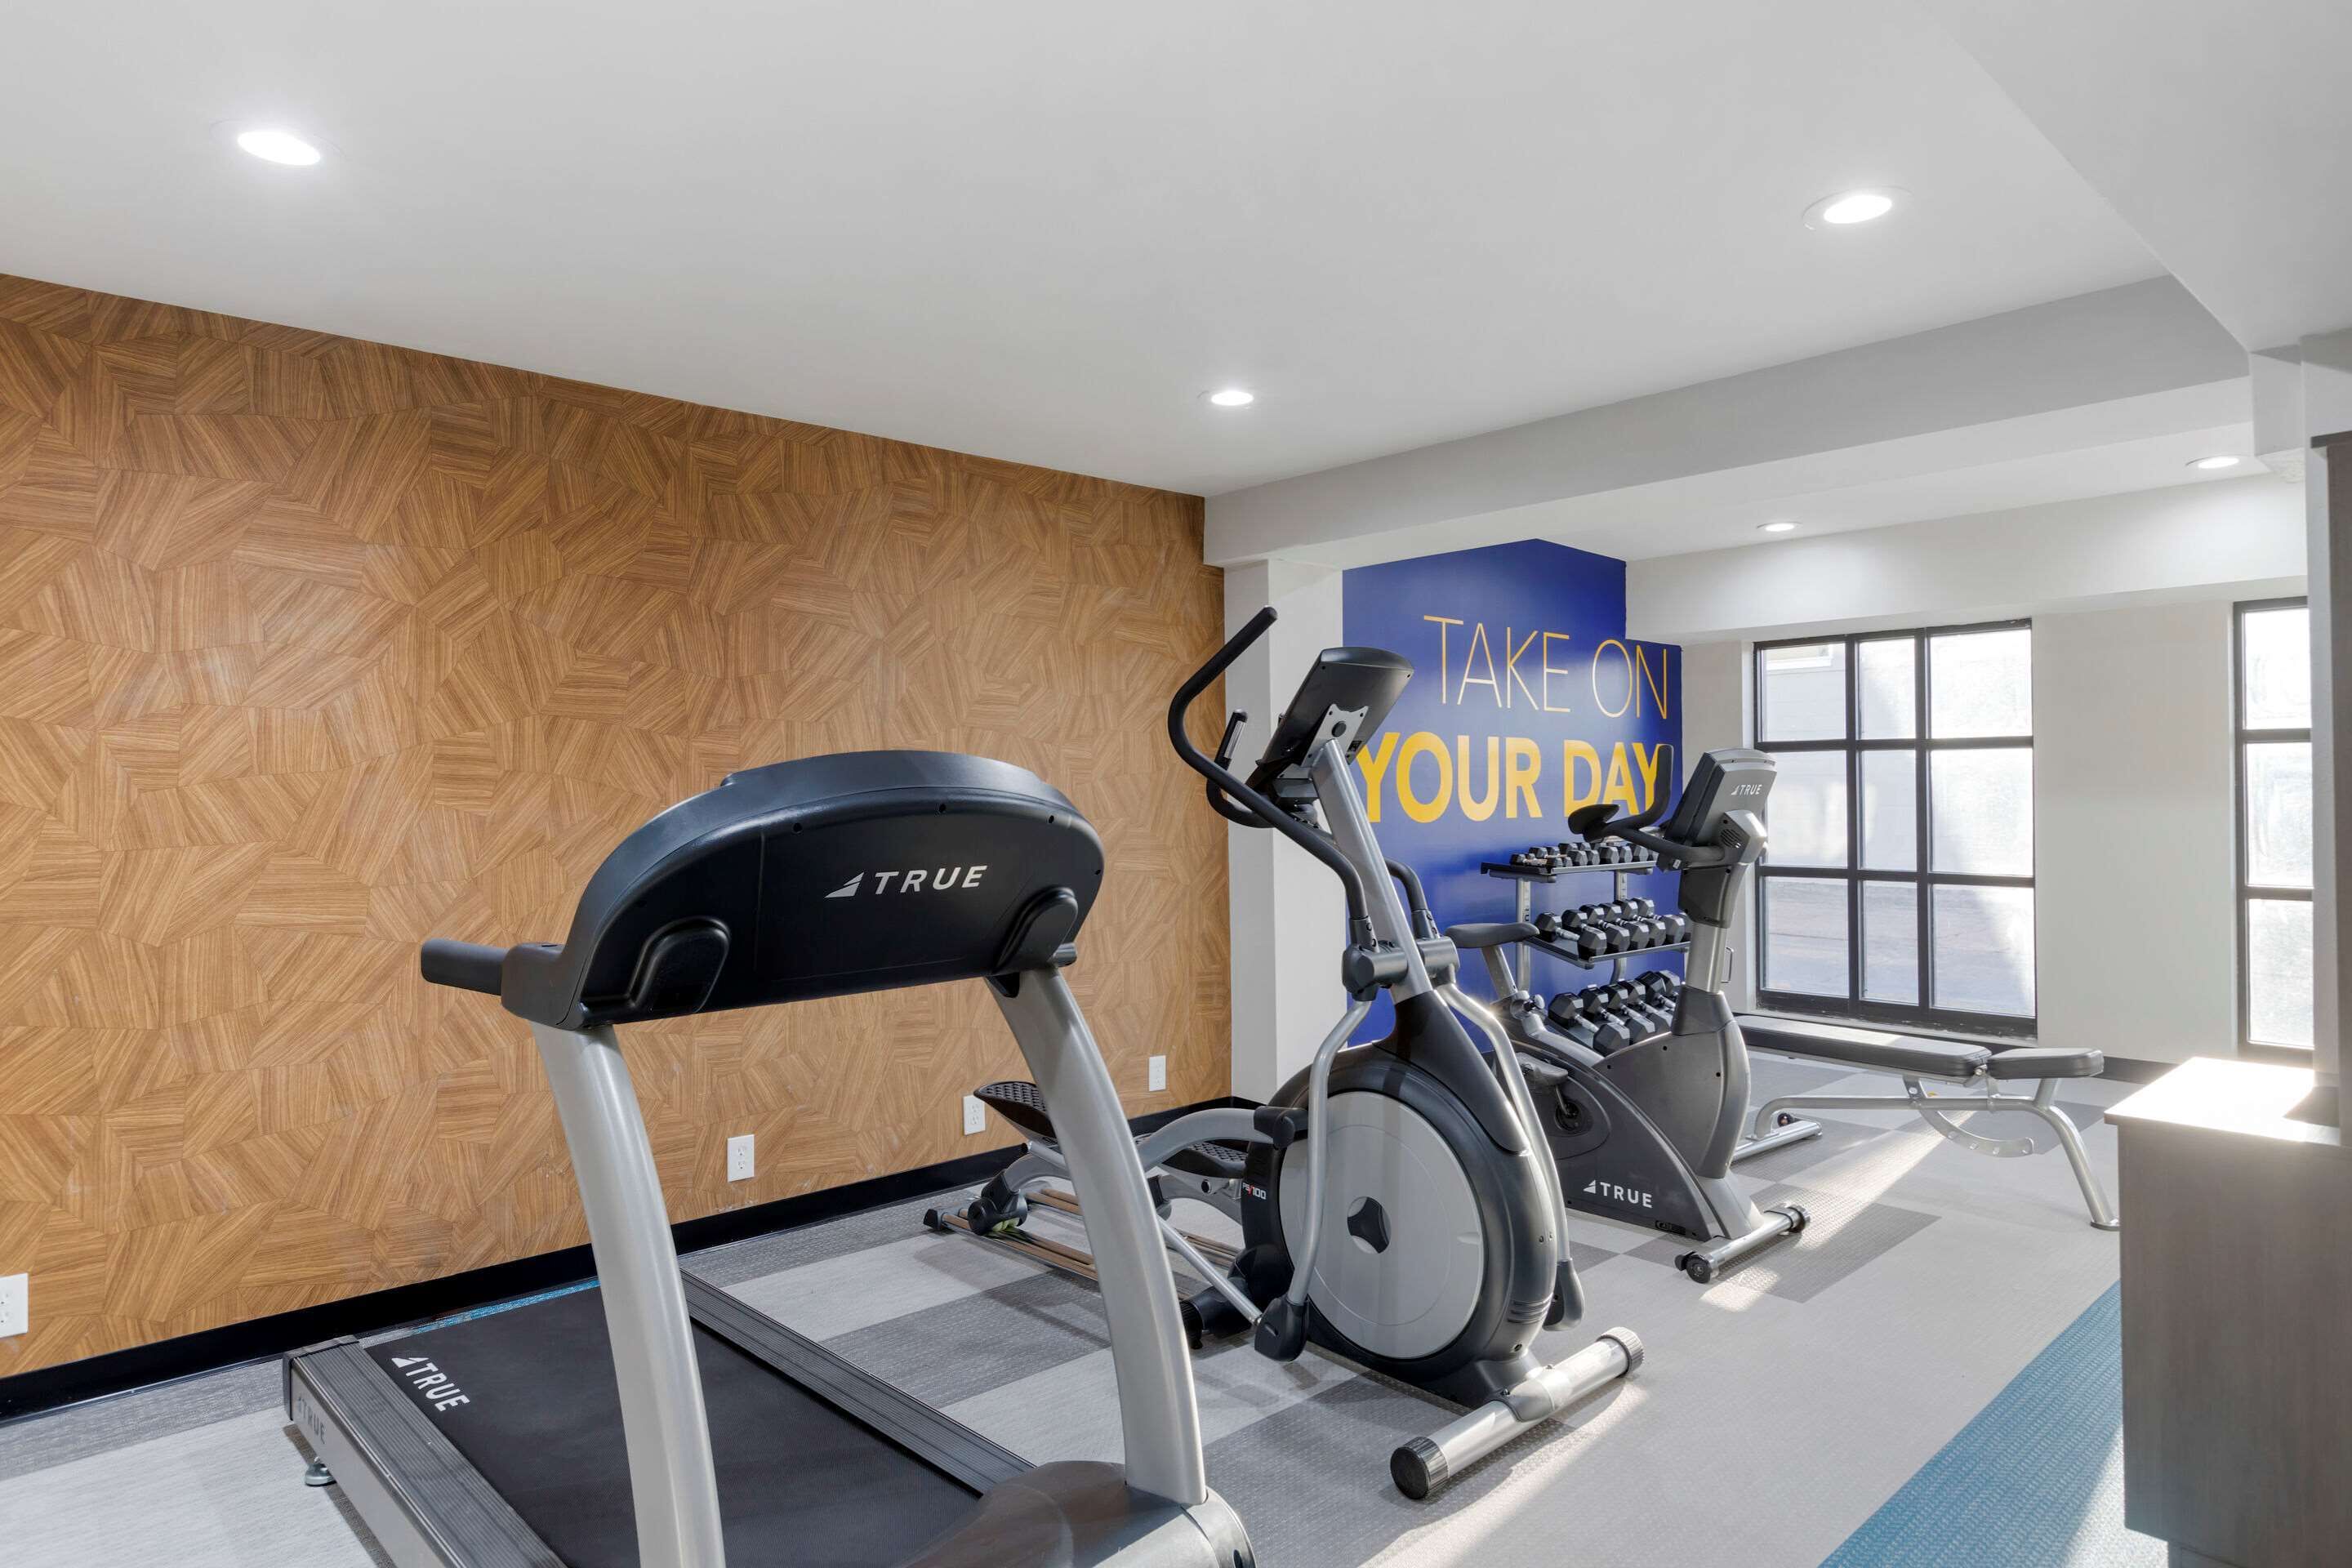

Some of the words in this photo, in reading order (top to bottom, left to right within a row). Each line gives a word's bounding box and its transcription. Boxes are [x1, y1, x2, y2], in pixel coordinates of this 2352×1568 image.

[1423, 615, 1570, 713] TAKE
[1592, 639, 1667, 719] ON
[1356, 731, 1543, 823] YOUR
[1563, 739, 1659, 817] DAY
[1739, 784, 1762, 796] TRUE
[875, 865, 988, 895] TRUE
[1600, 1181, 1654, 1209] TRUE
[405, 1361, 471, 1412] TRUE
[301, 1397, 326, 1445] TRUE
